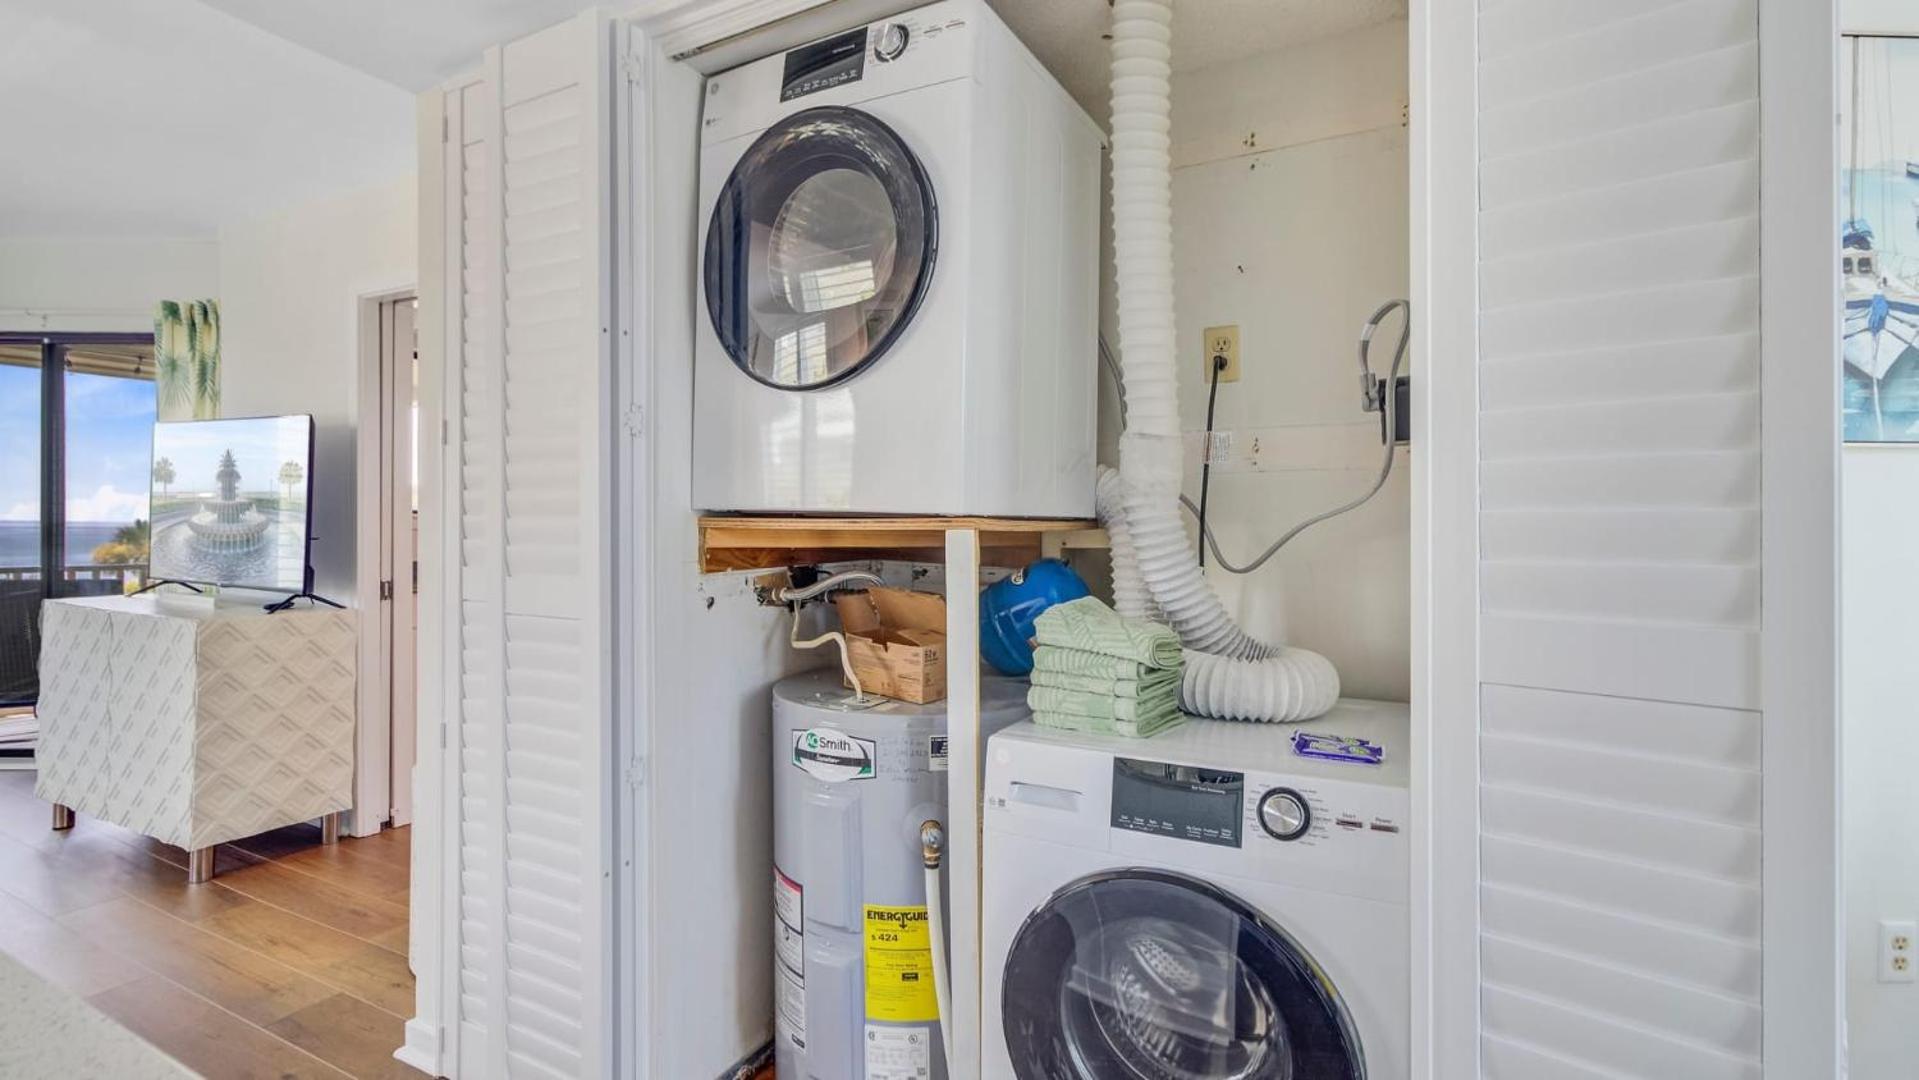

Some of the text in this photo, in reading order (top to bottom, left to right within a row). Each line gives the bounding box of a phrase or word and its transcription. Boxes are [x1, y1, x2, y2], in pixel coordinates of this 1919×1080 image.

[819, 737, 851, 752] Smith
[867, 910, 928, 921] ENERGYGUID
[878, 933, 898, 942] 424
